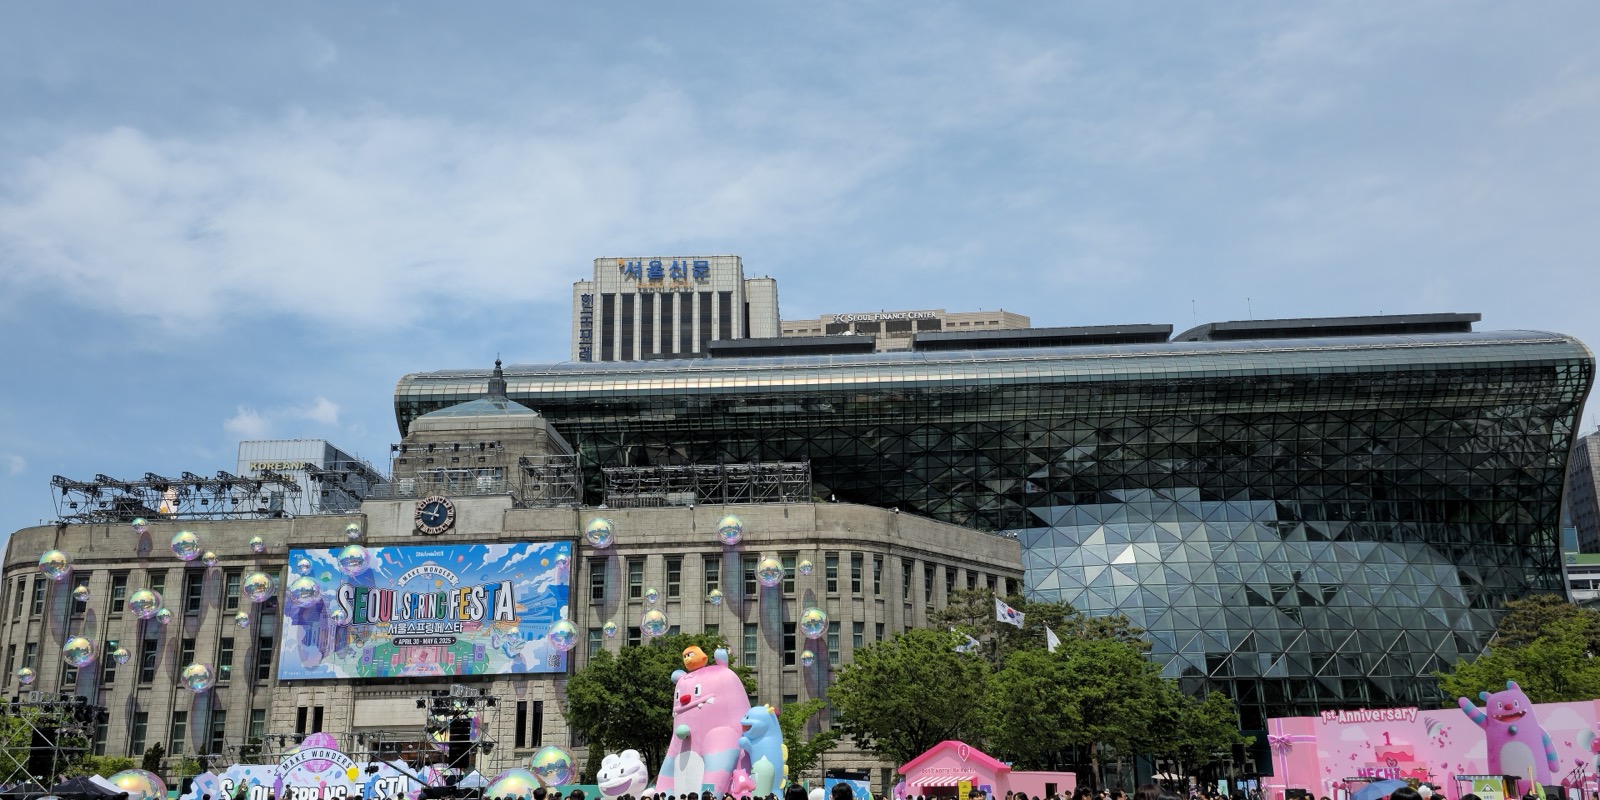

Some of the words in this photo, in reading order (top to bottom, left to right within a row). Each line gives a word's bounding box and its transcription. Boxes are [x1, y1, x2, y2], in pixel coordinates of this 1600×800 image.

[623, 260, 710, 280] 서울신문
[847, 313, 872, 322] SEOUL
[874, 312, 907, 321] FINANCE
[908, 310, 936, 319] CENTER
[250, 462, 306, 471] KOREANA
[402, 568, 420, 581] MAKE
[423, 566, 455, 581] WONDERS
[338, 583, 400, 623] SEOUL
[403, 591, 446, 620] SPRING
[449, 580, 515, 621] FESTA
[387, 621, 464, 635] 서울스프링페스타
[1321, 709, 1336, 725] 1st
[1338, 706, 1418, 723] Anniversary
[282, 753, 306, 771] MAKE
[312, 751, 353, 769] WONDERS
